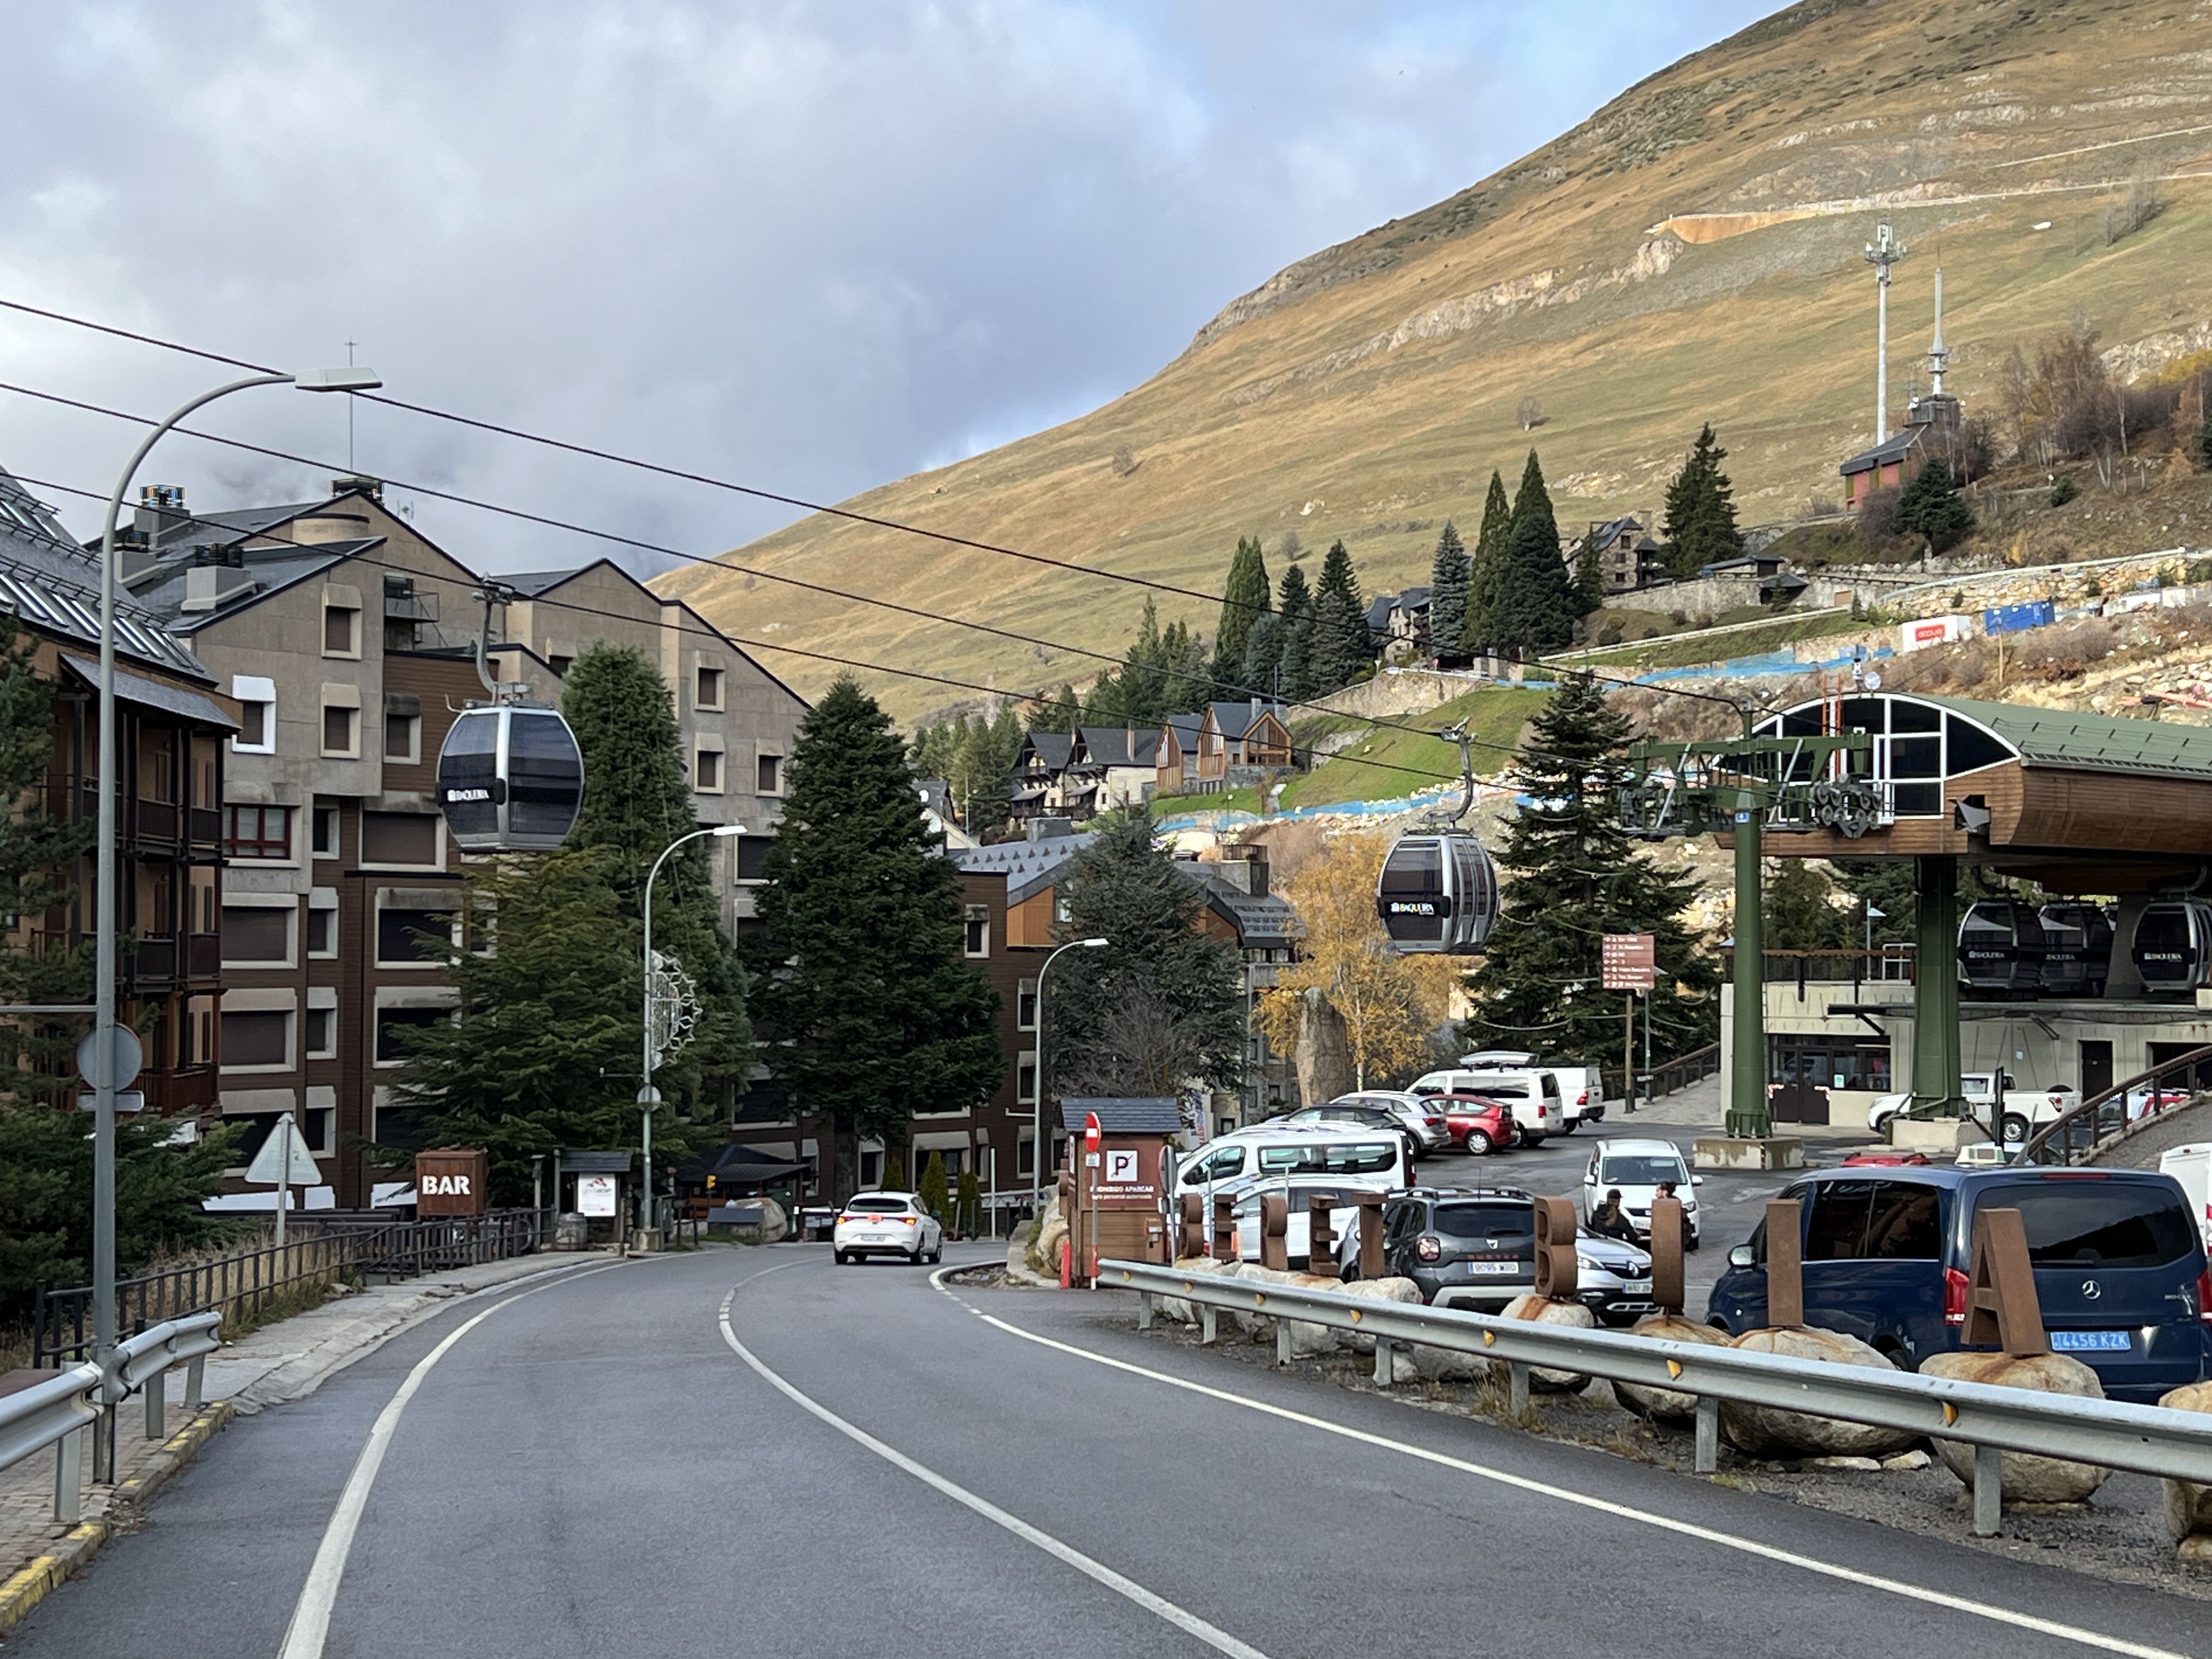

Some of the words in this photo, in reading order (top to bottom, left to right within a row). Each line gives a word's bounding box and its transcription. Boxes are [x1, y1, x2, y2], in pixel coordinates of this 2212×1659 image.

[1115, 1155, 1129, 1176] P
[422, 1175, 471, 1195] BAR
[1178, 1191, 1389, 1280] BERET
[2062, 1333, 2097, 1347] 4456
[2100, 1333, 2128, 1347] KZK
